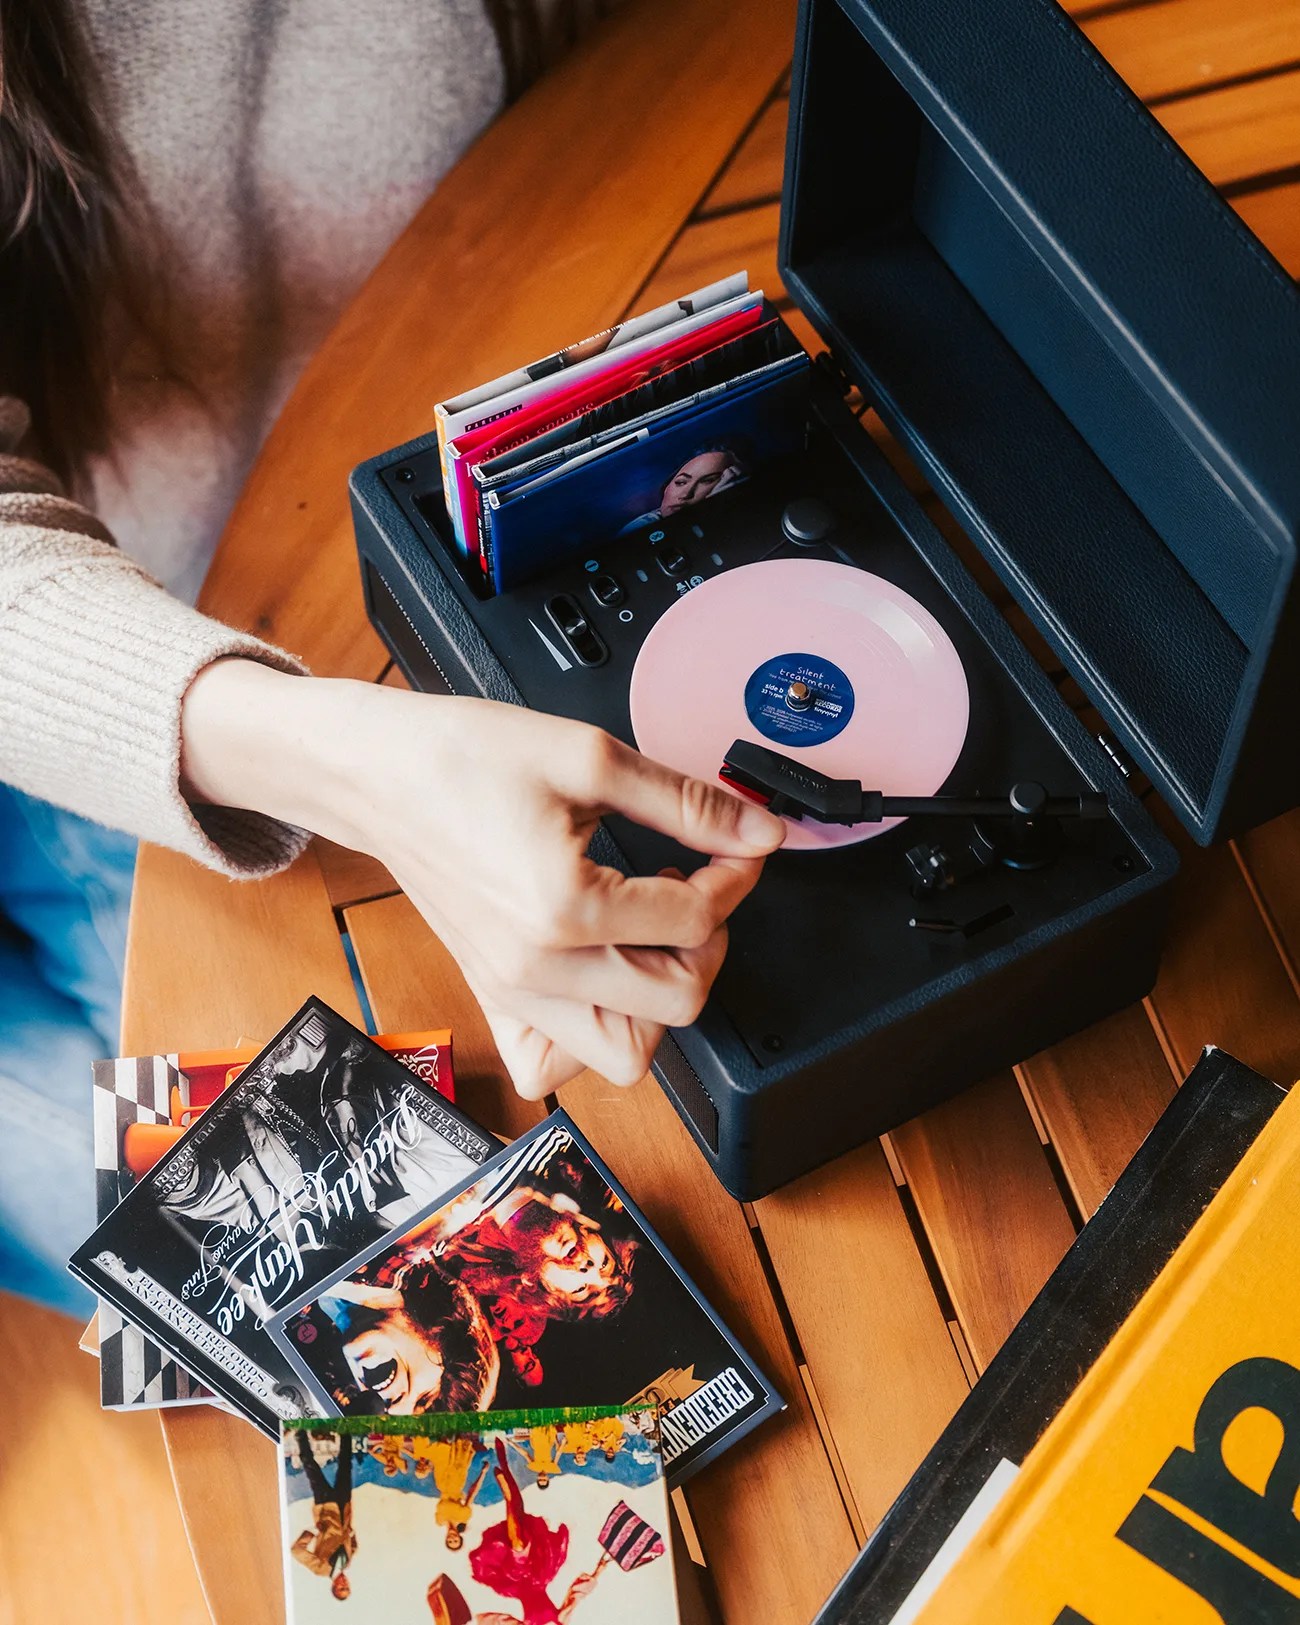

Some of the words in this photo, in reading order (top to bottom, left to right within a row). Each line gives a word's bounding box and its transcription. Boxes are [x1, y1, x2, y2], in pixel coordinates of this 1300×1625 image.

[765, 684, 779, 692] side
[780, 668, 836, 691] treatment
[797, 667, 824, 679] Silent
[289, 1084, 423, 1230] Daddy
[430, 1118, 484, 1164] CARTEL
[206, 1178, 325, 1336] Yankee
[123, 1277, 152, 1302] SAN
[183, 1327, 238, 1373] PUERTO
[234, 1368, 270, 1399] RICO
[137, 1275, 158, 1294] EL
[153, 1289, 208, 1335] CARTEL
[203, 1331, 268, 1384] RECORDS
